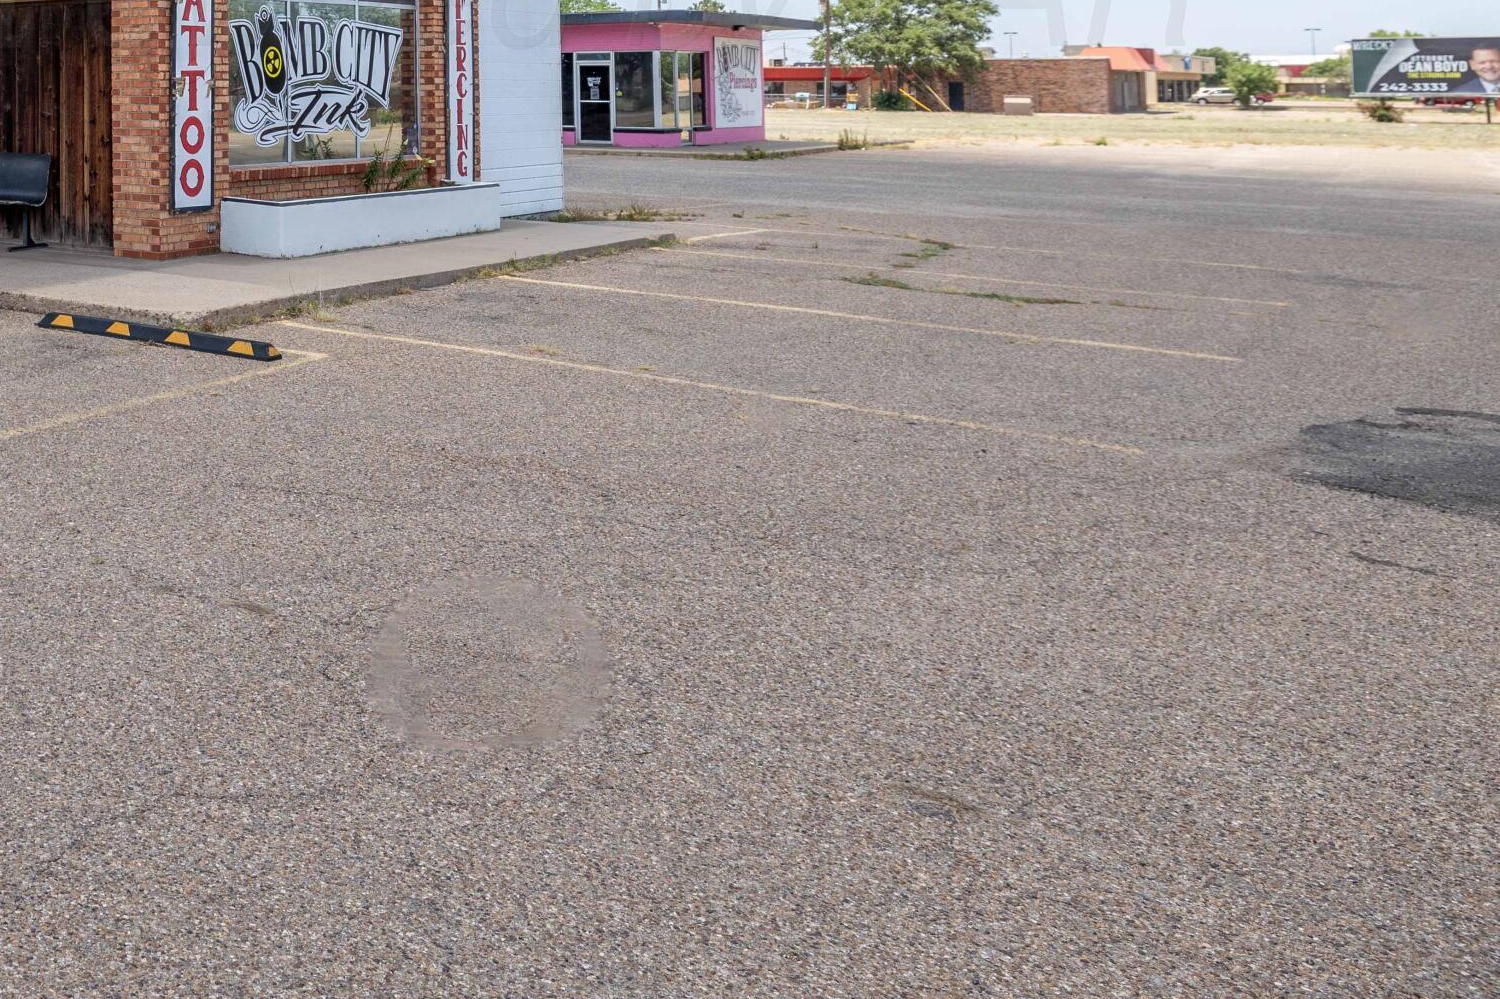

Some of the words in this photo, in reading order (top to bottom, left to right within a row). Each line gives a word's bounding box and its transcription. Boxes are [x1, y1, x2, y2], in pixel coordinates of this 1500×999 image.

[333, 18, 403, 108] CITY
[1398, 61, 1432, 72] DEAN
[1434, 61, 1468, 72] BOYD
[729, 72, 757, 92] Piercings
[1379, 83, 1448, 91] 242-3333
[260, 87, 367, 143] Ink
